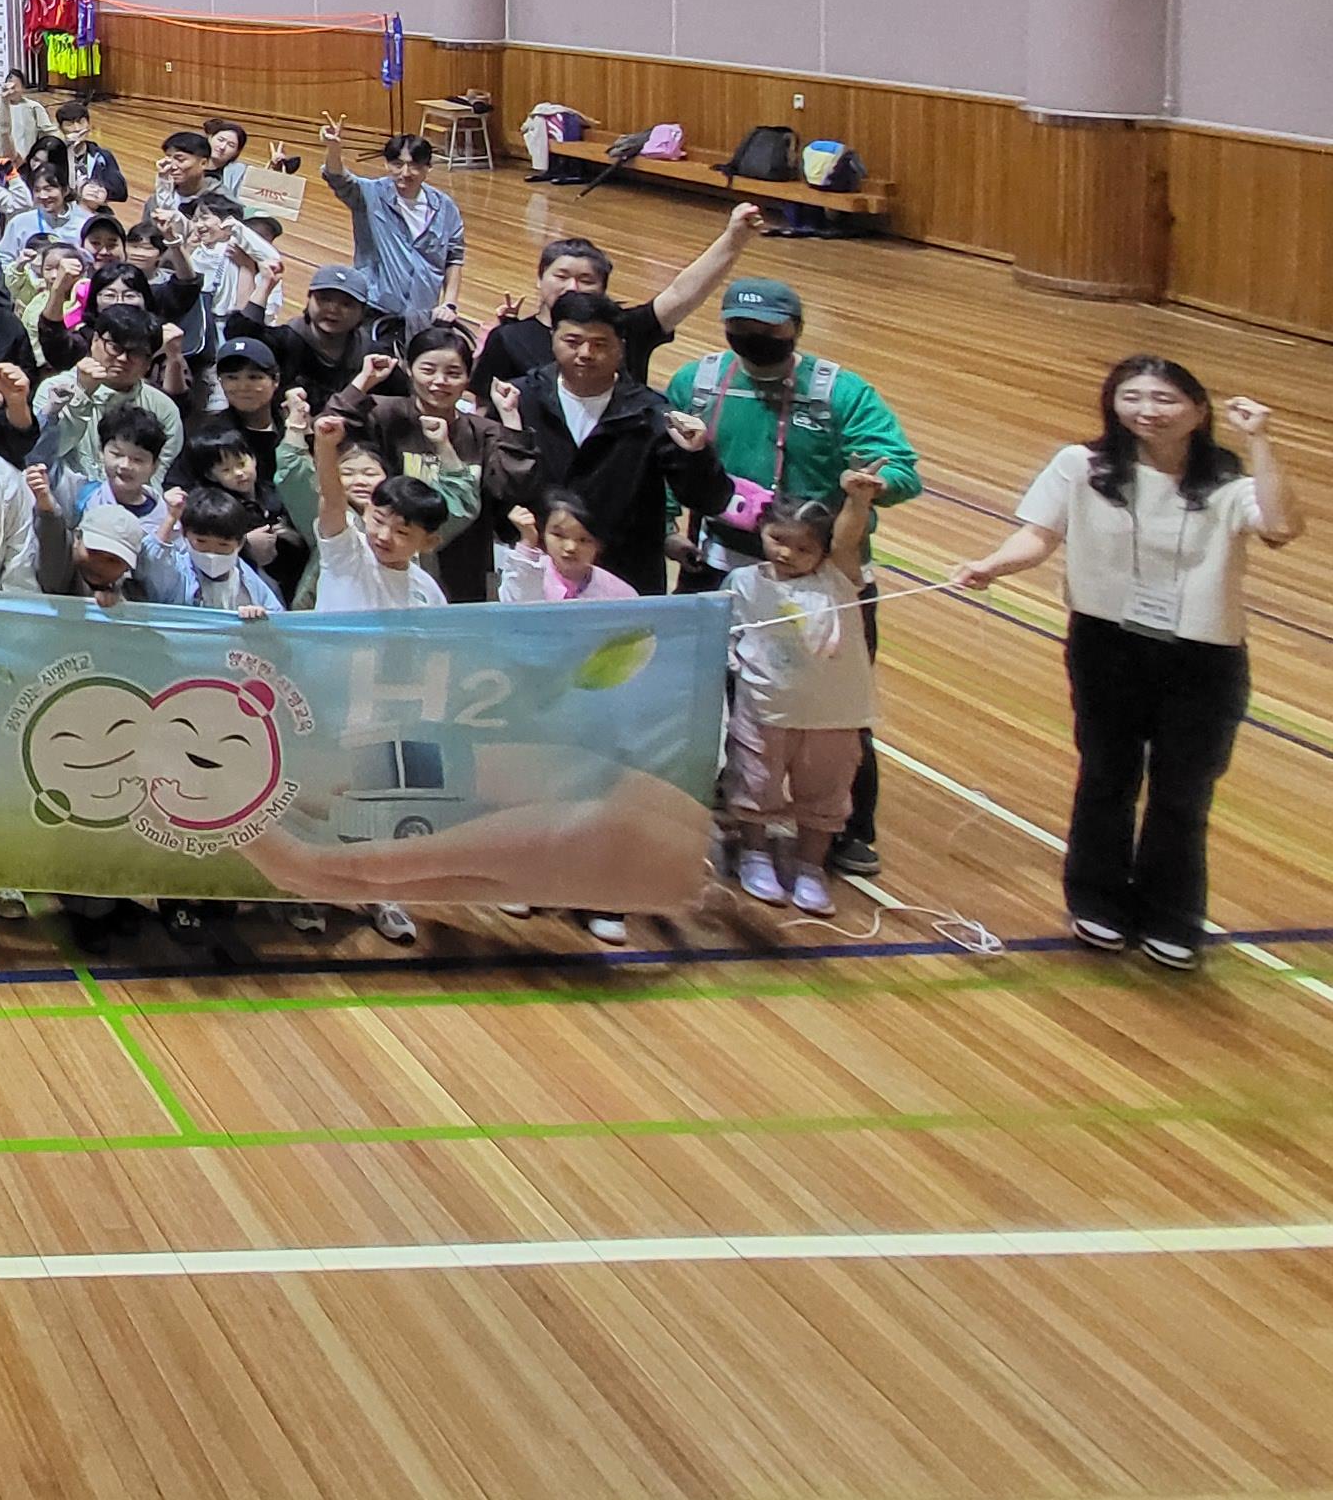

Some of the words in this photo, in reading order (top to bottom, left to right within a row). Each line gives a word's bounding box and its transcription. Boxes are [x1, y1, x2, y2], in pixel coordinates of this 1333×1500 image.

[41, 654, 91, 687] 신명학교
[135, 817, 180, 849] Smile
[185, 780, 299, 855] Eye-Talk-Mind
